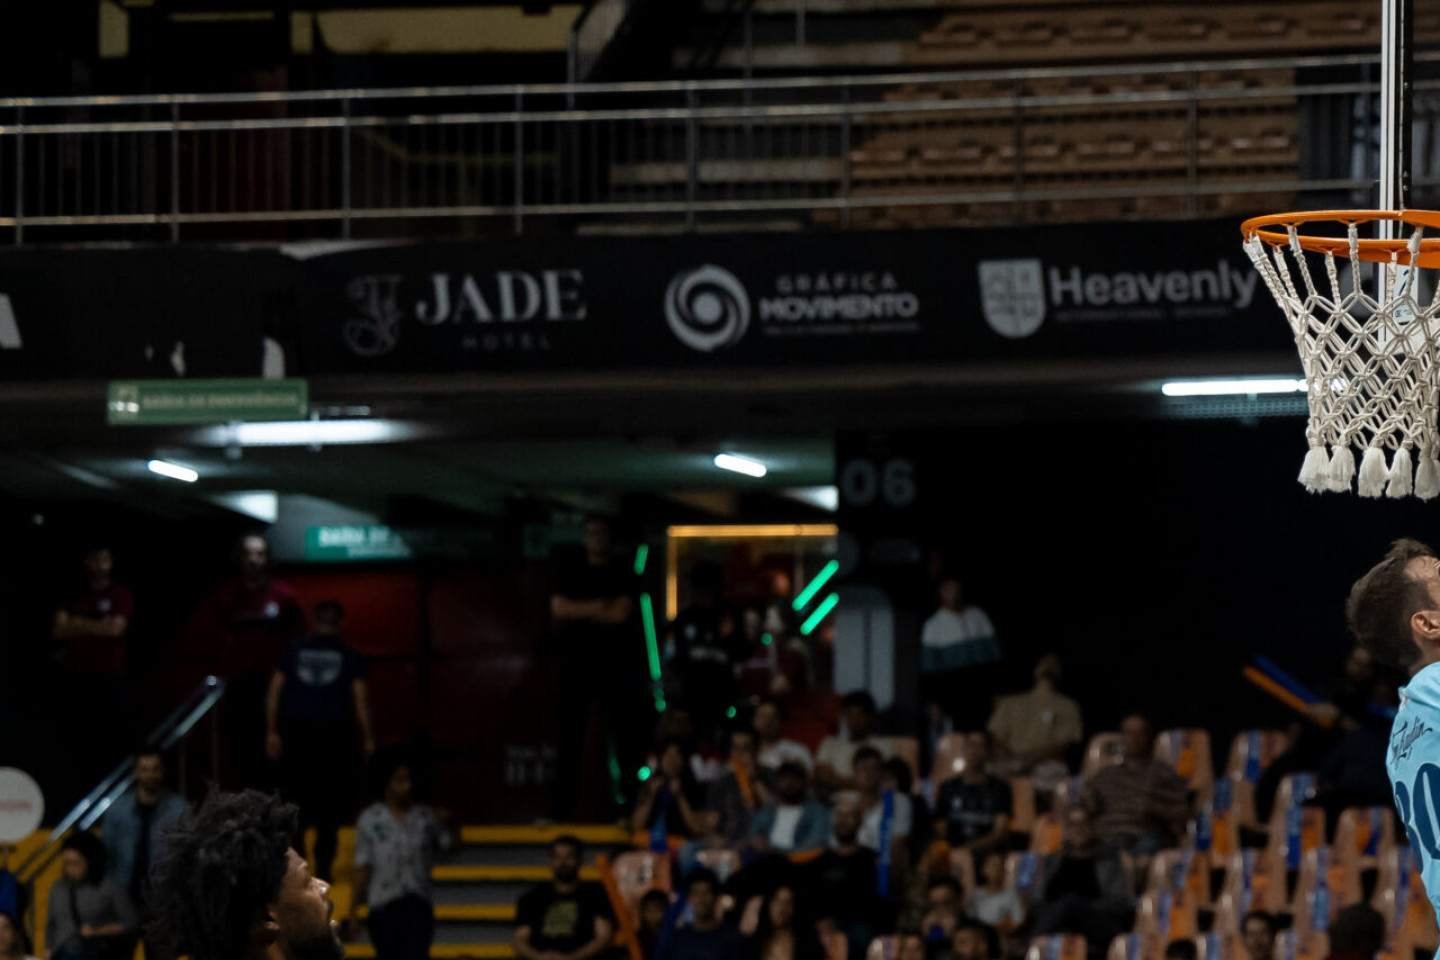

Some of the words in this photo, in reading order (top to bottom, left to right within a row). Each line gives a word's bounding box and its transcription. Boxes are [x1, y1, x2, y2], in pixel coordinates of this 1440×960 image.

[414, 269, 588, 326] JADE
[760, 293, 919, 321] MOVIMENTO
[1048, 259, 1258, 309] Heavenly
[842, 457, 918, 509] 06
